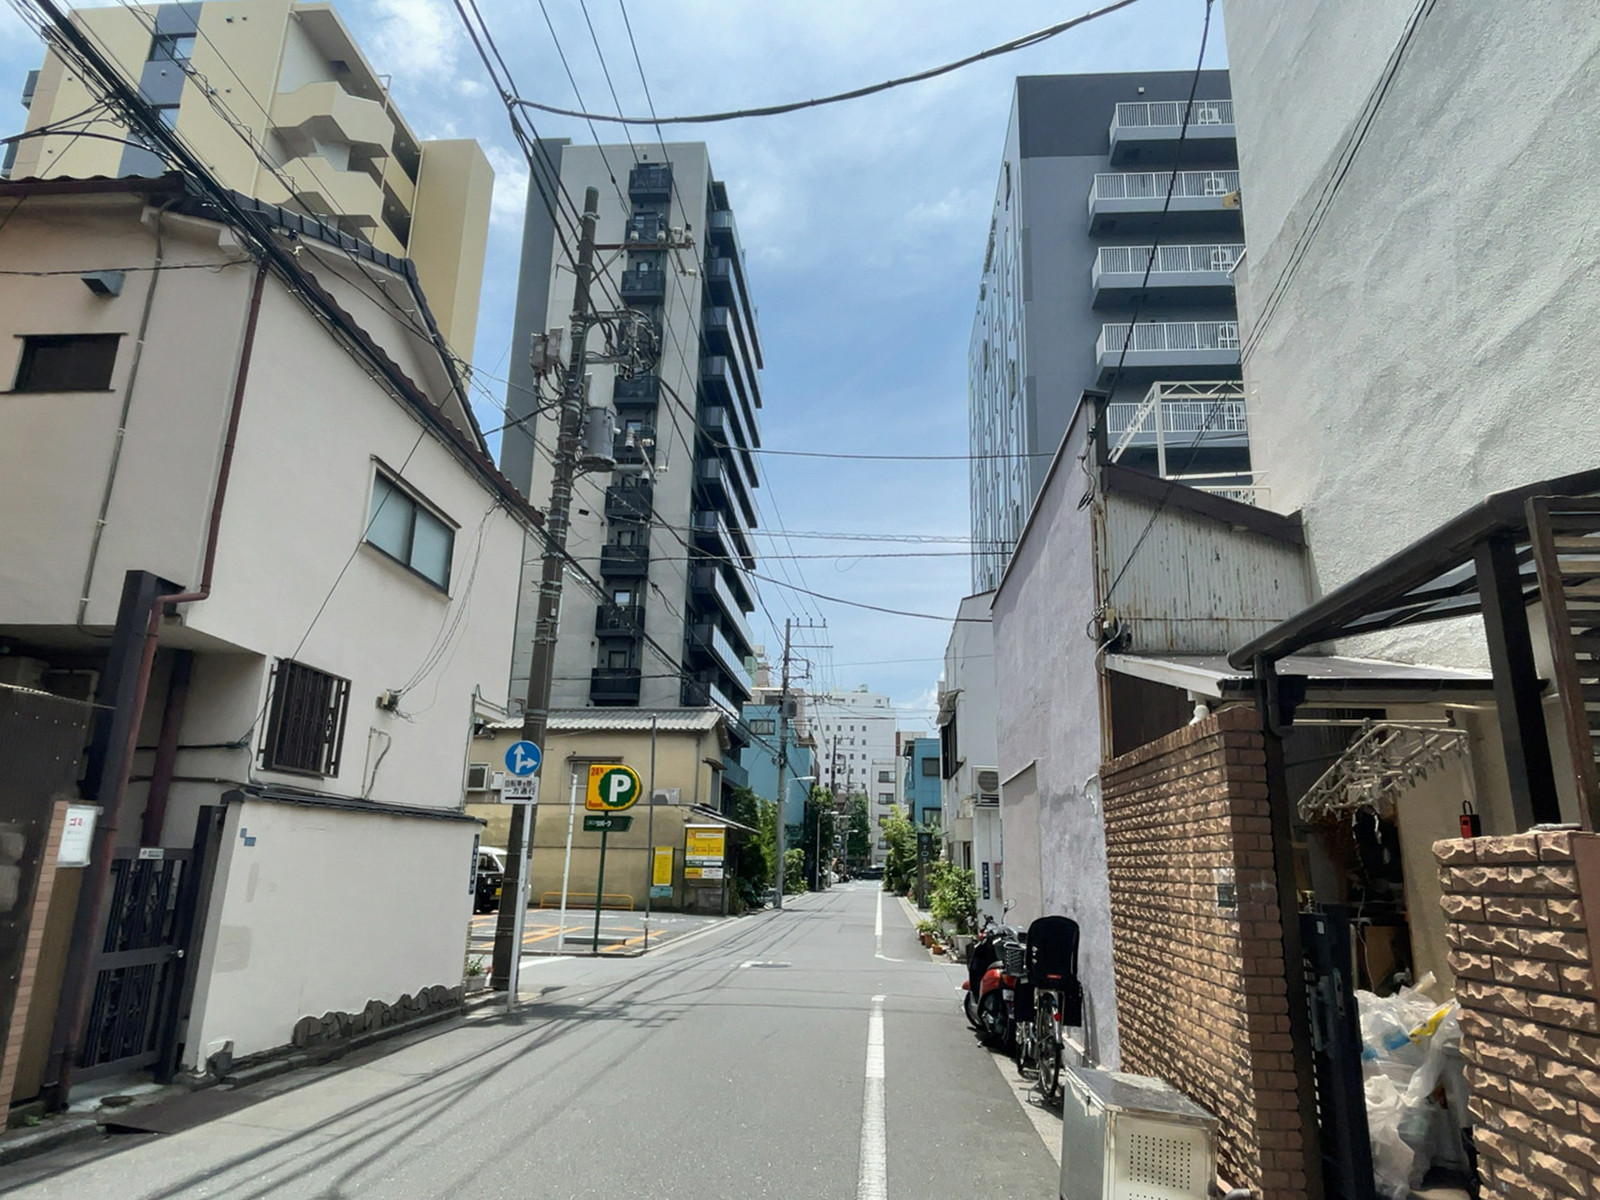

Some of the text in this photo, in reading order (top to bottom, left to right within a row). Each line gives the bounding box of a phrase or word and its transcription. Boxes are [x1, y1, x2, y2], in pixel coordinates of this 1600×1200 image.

[504, 787, 536, 795] 一方通行
[609, 774, 632, 802] P
